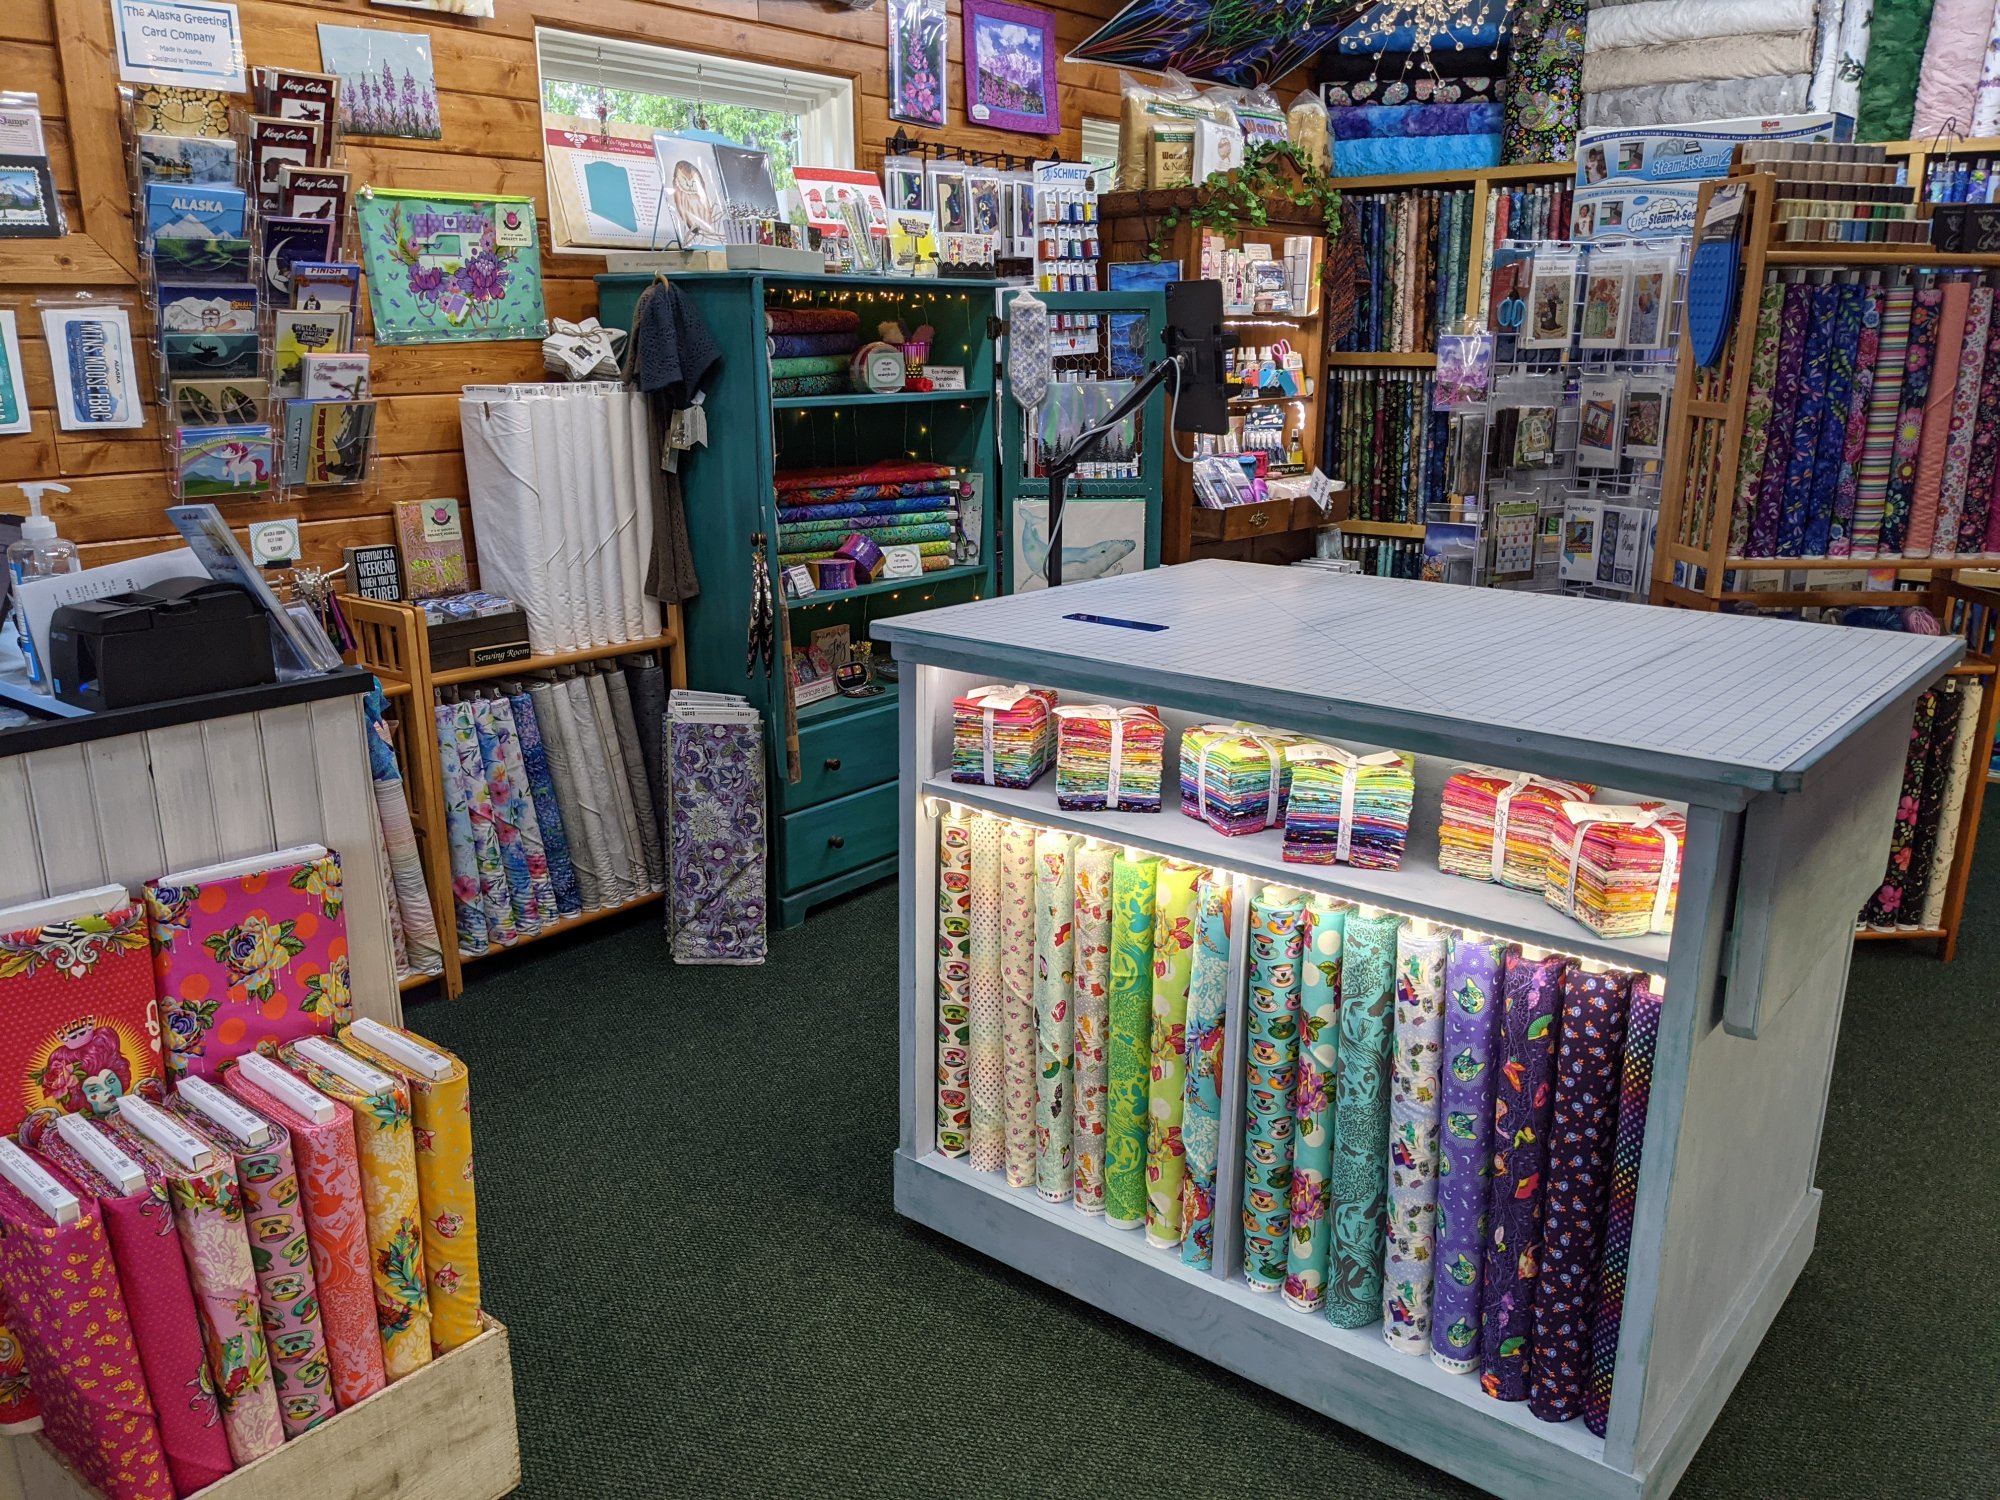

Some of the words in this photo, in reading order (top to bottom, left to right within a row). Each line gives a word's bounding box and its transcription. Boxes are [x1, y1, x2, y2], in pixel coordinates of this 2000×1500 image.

[123, 5, 145, 17] The
[146, 9, 181, 22] Alaska
[184, 13, 228, 28] Greeting
[141, 25, 167, 38] Card
[170, 29, 216, 43] Company
[282, 79, 303, 94] Keep
[304, 82, 327, 94] Calm
[1244, 118, 1277, 135] Warm
[262, 128, 284, 142] Keep
[285, 129, 308, 141] Calm
[1720, 146, 1733, 166] 2
[1053, 167, 1088, 180] SCHMETZ
[294, 177, 316, 191] Keep
[316, 179, 339, 190] Calm
[171, 198, 224, 213] ALASKA
[1631, 216, 1648, 229] Lite
[1648, 210, 1697, 225] Steam-A-Sea
[311, 266, 342, 274] FINISH
[80, 324, 104, 353] MTNS
[84, 356, 109, 390] MOOSE
[114, 360, 122, 384] ALASKA
[88, 393, 113, 419] FBRC
[356, 550, 382, 562] EVERYDAY
[383, 549, 389, 559] IS
[390, 549, 394, 558] A
[358, 560, 396, 577] WEEKEND
[360, 577, 377, 588] WHEN
[377, 574, 398, 586] YOU'RE
[361, 585, 399, 600] RETIRED
[476, 651, 505, 662] Sewing
[506, 648, 530, 657] Room
[798, 687, 820, 699] manicure
